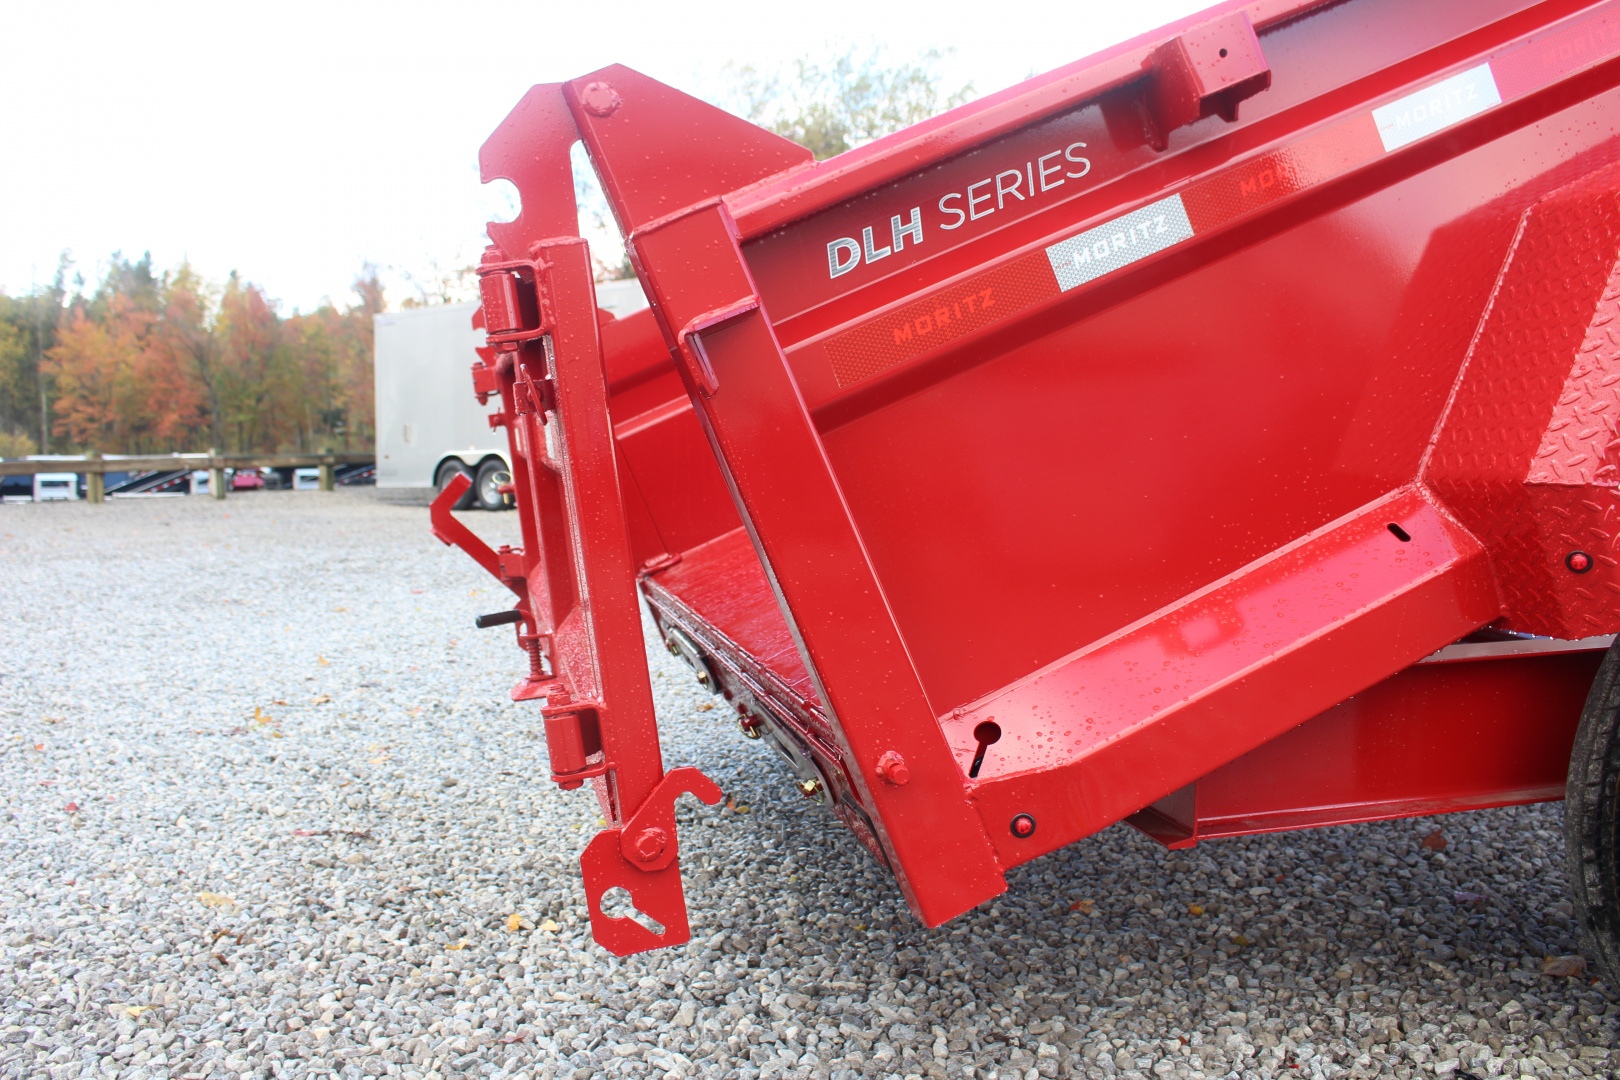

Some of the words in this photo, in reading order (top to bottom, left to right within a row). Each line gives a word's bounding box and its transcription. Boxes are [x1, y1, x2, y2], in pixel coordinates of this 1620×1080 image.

[1394, 82, 1478, 130] MORITZ
[827, 206, 924, 279] DLH
[938, 142, 1091, 230] SERIES
[1072, 215, 1168, 269] MORITZ
[893, 287, 995, 345] MORITZ
